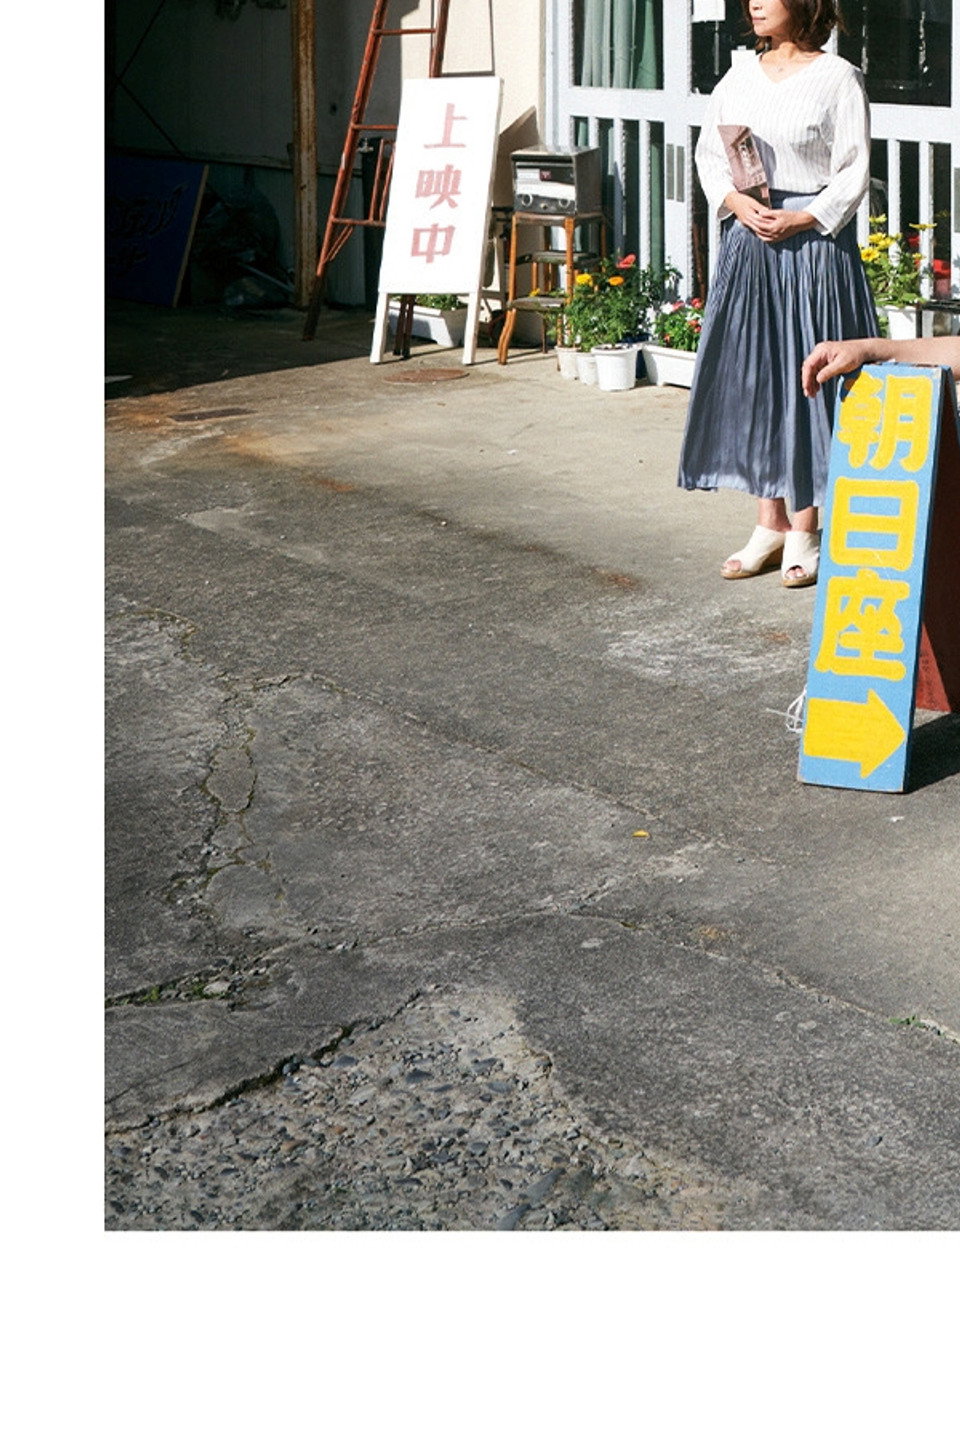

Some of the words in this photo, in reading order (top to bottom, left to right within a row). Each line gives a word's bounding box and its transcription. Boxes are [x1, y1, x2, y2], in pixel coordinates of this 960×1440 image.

[410, 102, 467, 264] 上映中
[814, 371, 933, 682] 朝日座
